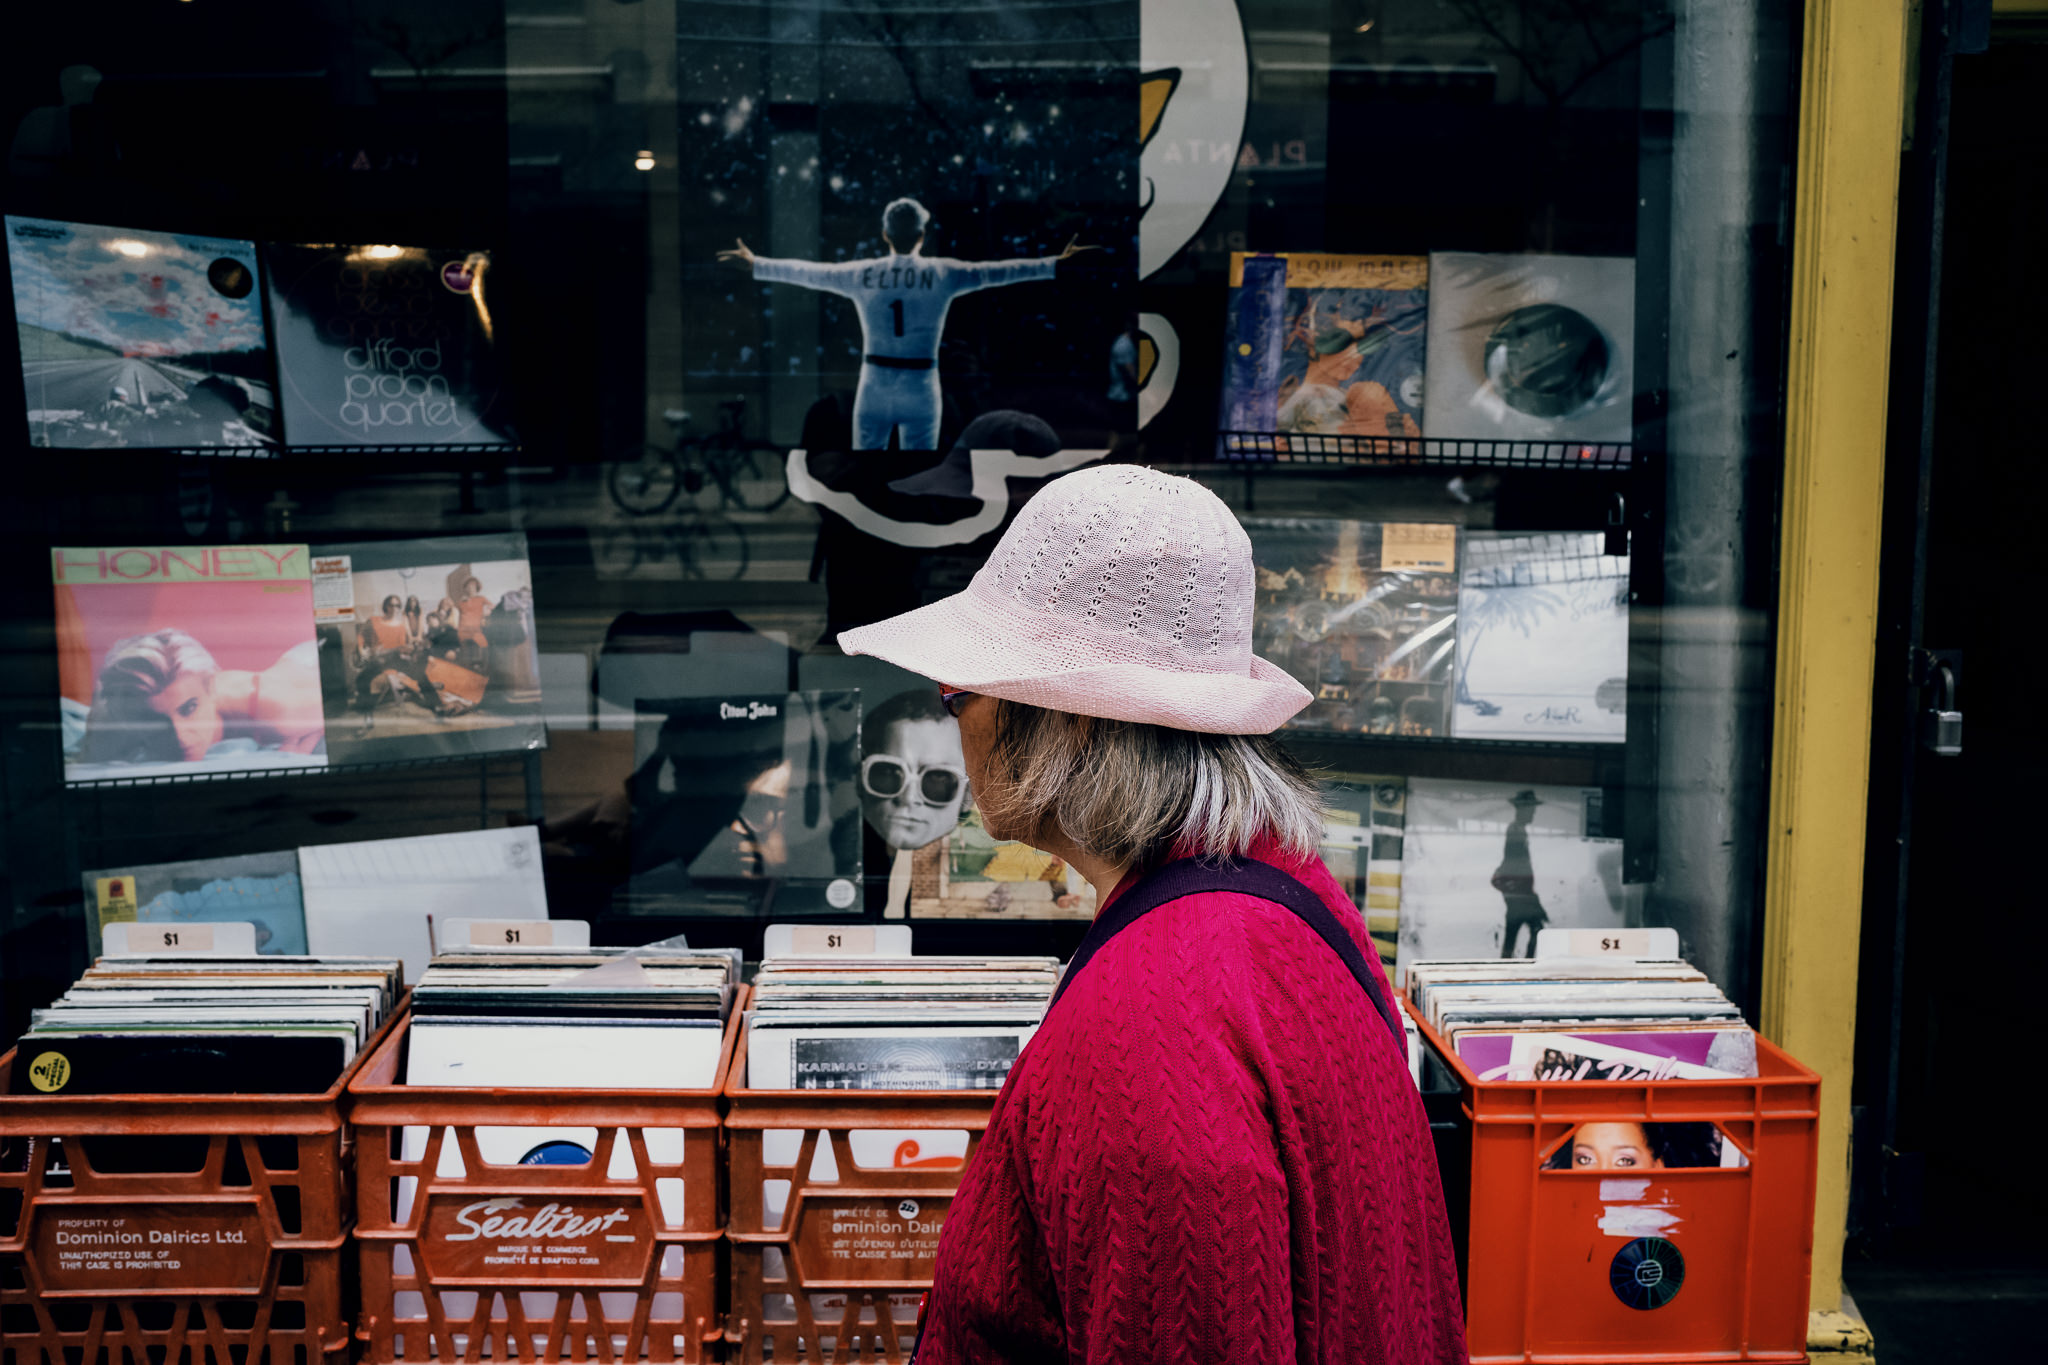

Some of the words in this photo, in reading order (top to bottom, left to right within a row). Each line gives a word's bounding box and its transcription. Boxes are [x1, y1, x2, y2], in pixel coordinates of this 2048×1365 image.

[862, 267, 934, 290] ELTON
[888, 299, 904, 337] 1
[343, 336, 442, 372] clifford
[344, 368, 450, 401] jordan
[339, 395, 463, 433] quartet
[55, 548, 299, 580] HONEY
[720, 701, 748, 720] Elton
[748, 701, 777, 720] John
[164, 933, 179, 946] $1
[506, 929, 520, 943] $1
[827, 935, 842, 948] $1
[1601, 938, 1620, 951] $1
[34, 1066, 46, 1076] 2
[58, 1219, 108, 1228] PROPERTY
[112, 1219, 126, 1228] OF
[445, 1197, 630, 1242] Sealtest
[56, 1230, 144, 1245] Dominion
[148, 1229, 211, 1244] Dairies
[215, 1229, 248, 1244] Ltd.
[59, 1251, 132, 1260] UNAUTHORIZED
[134, 1250, 154, 1259] USE
[156, 1250, 170, 1259] OF
[855, 1250, 887, 1259] CAISSE
[890, 1250, 914, 1259] SANS
[60, 1261, 82, 1270] THIS
[86, 1261, 111, 1270] CASE
[114, 1261, 124, 1270] IS
[125, 1260, 181, 1270] PROHIBITED
